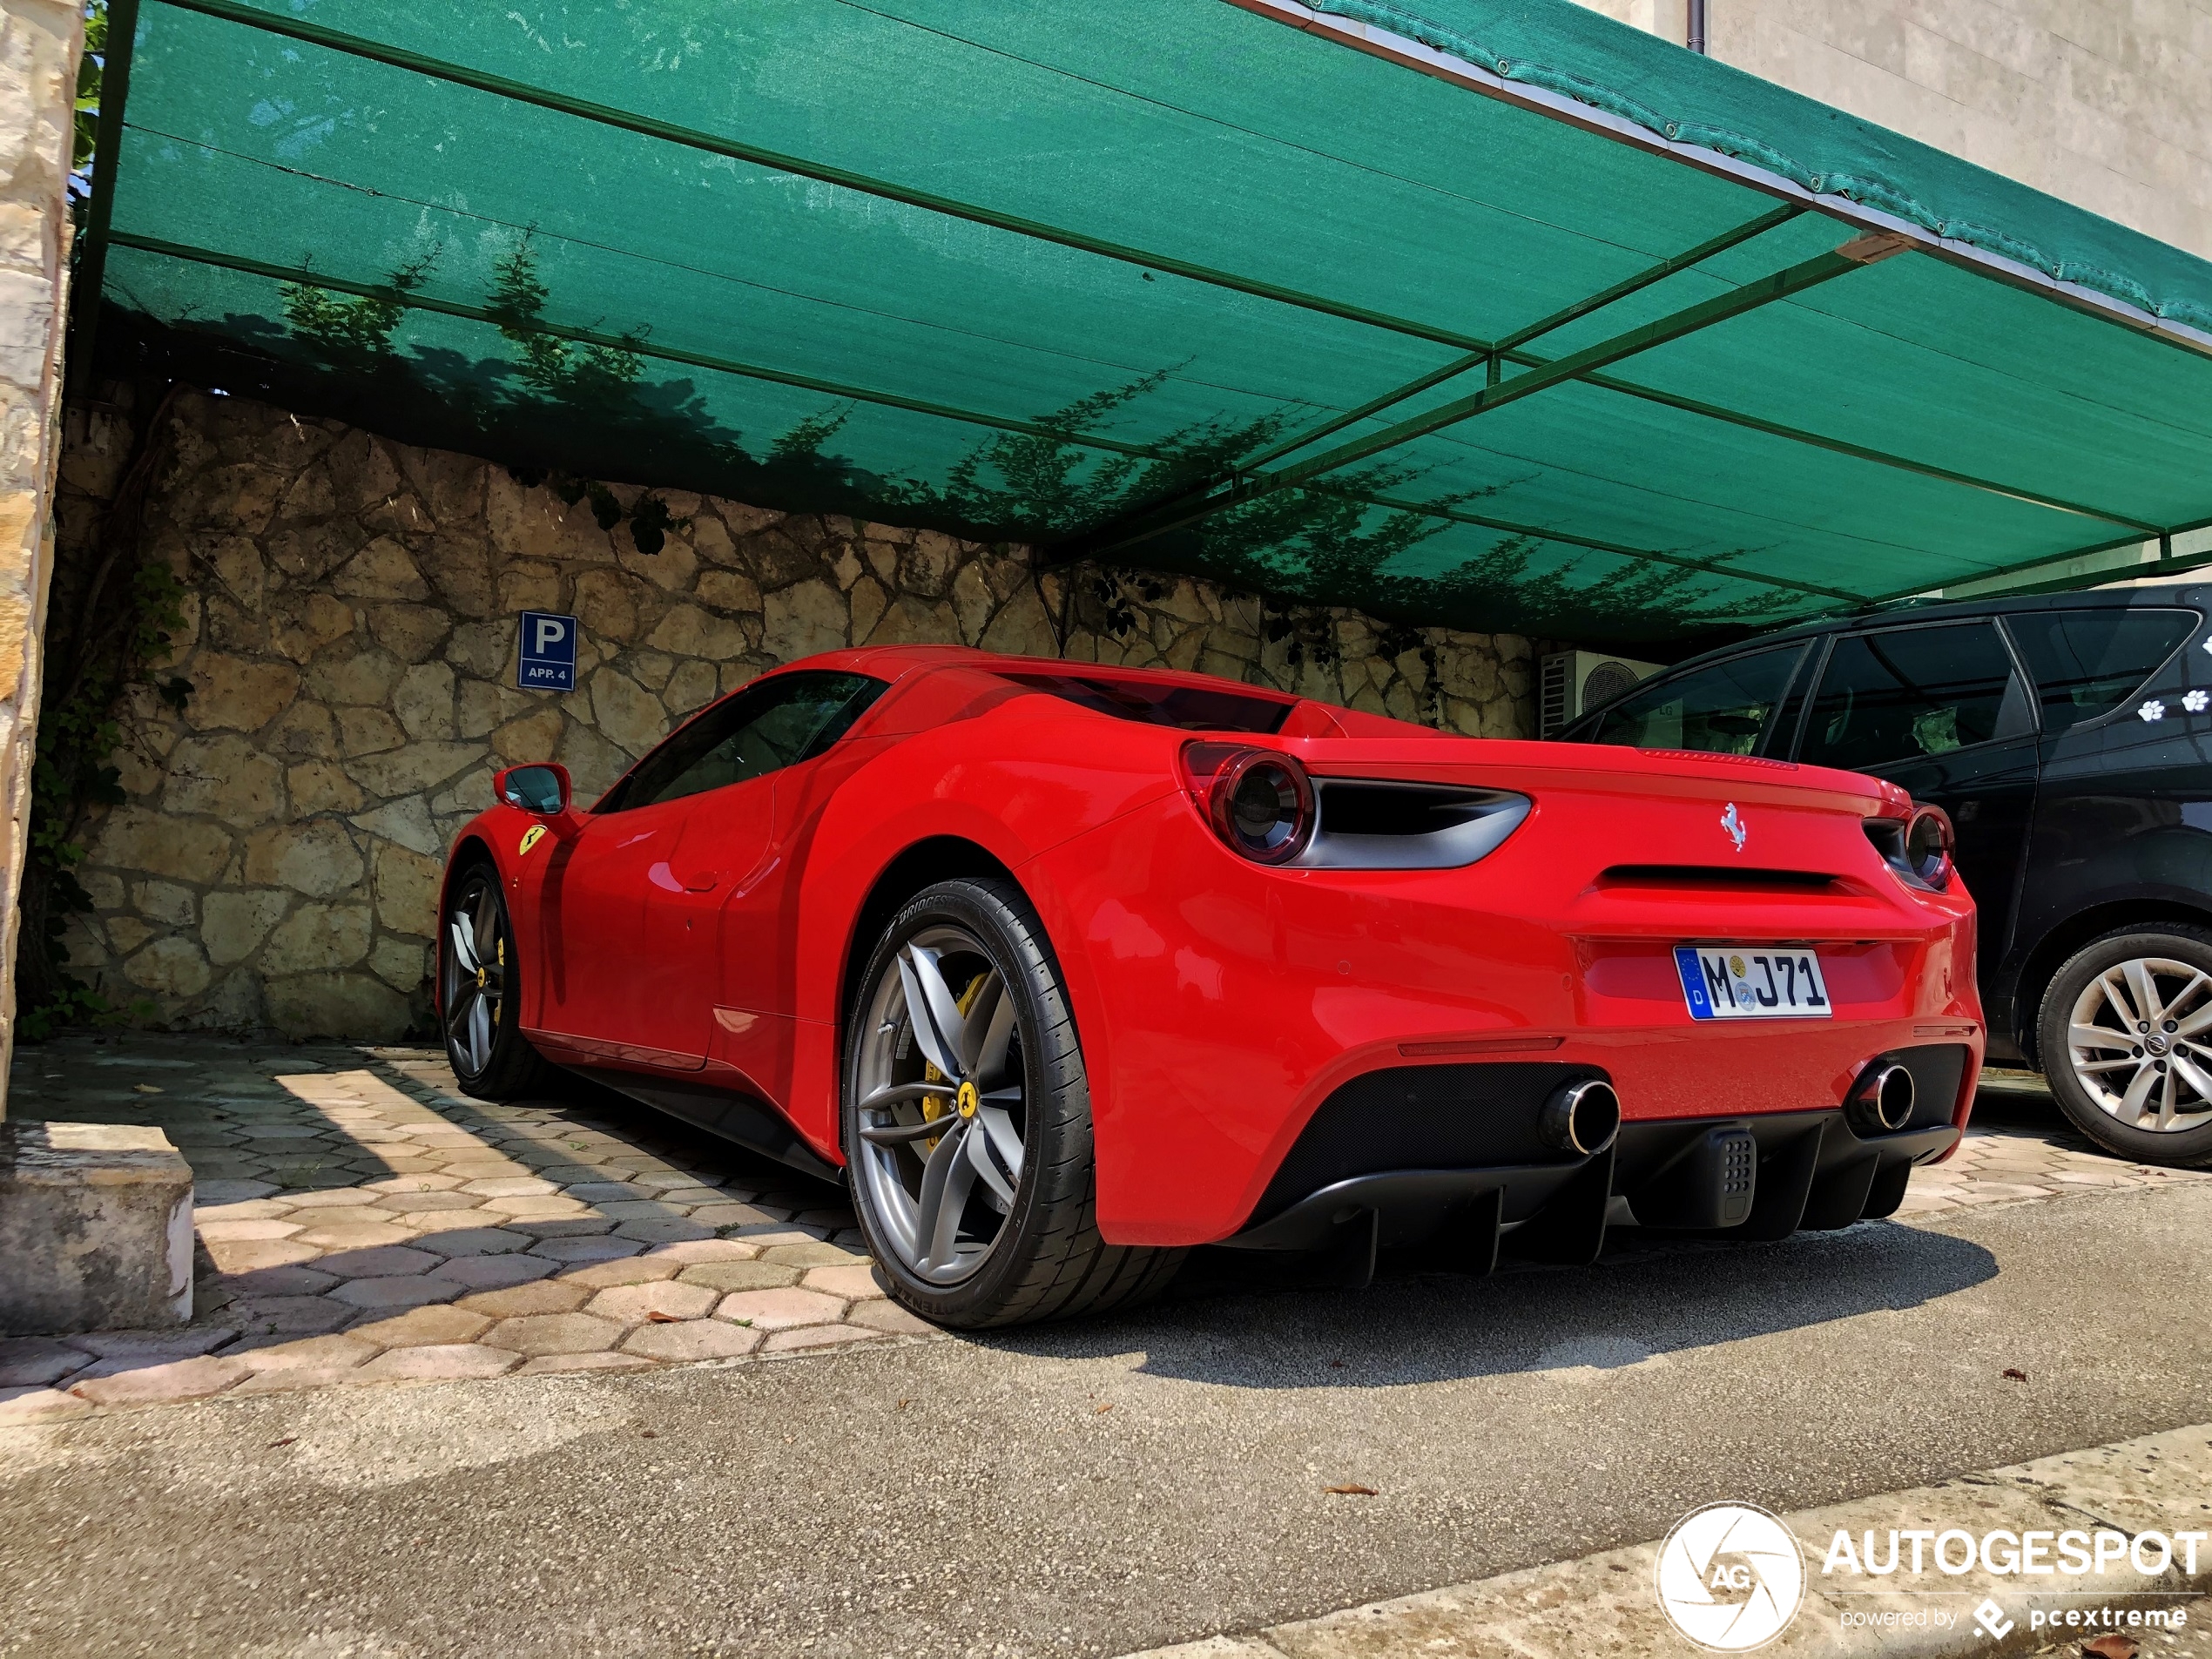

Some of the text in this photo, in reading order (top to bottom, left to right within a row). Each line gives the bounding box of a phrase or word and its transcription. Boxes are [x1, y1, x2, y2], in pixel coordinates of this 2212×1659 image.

[536, 618, 565, 654] P
[529, 667, 566, 680] APP. 4
[1659, 705, 1673, 716] LG
[1692, 989, 1704, 1005] D
